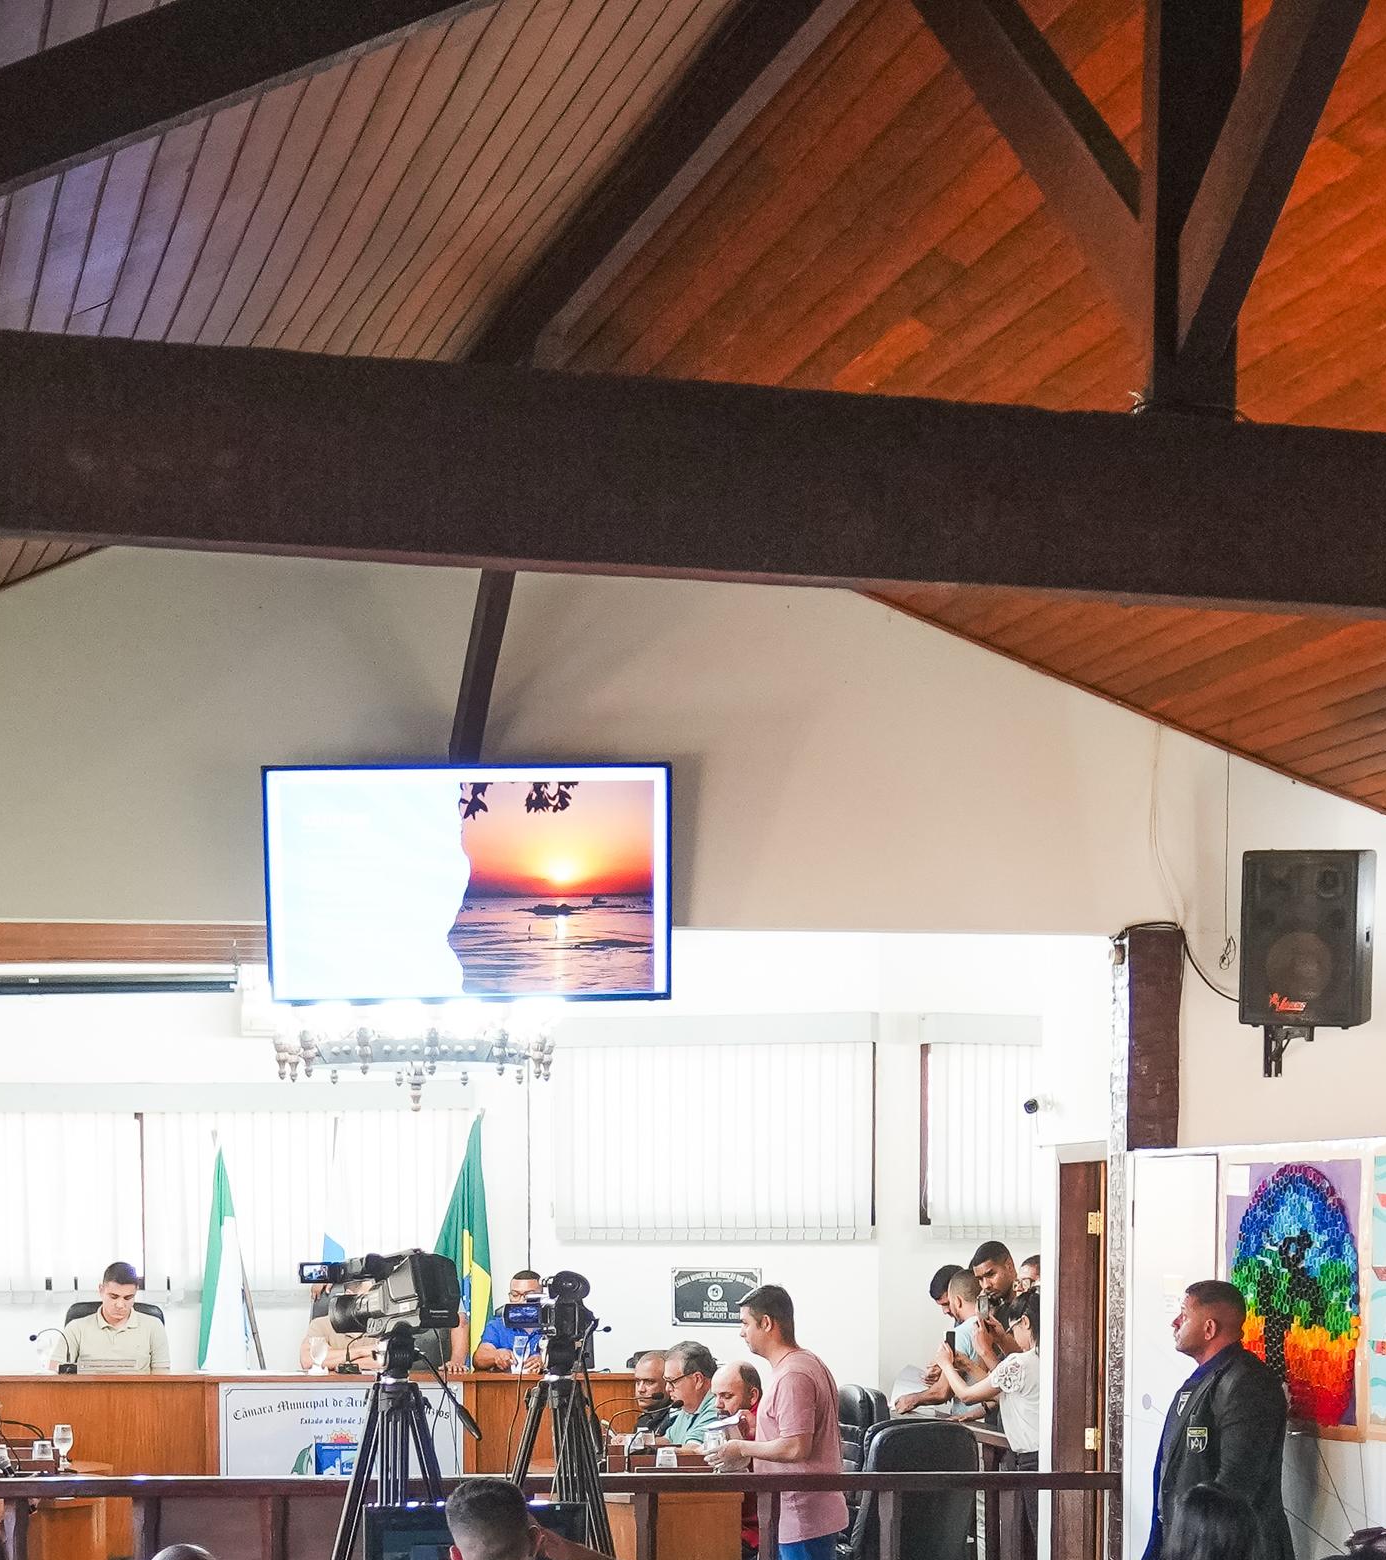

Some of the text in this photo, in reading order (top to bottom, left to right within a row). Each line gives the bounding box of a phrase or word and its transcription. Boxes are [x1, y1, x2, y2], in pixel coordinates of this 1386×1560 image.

[233, 1405, 274, 1421] Câmara
[277, 1397, 329, 1412] Municipal
[332, 1398, 343, 1408] de
